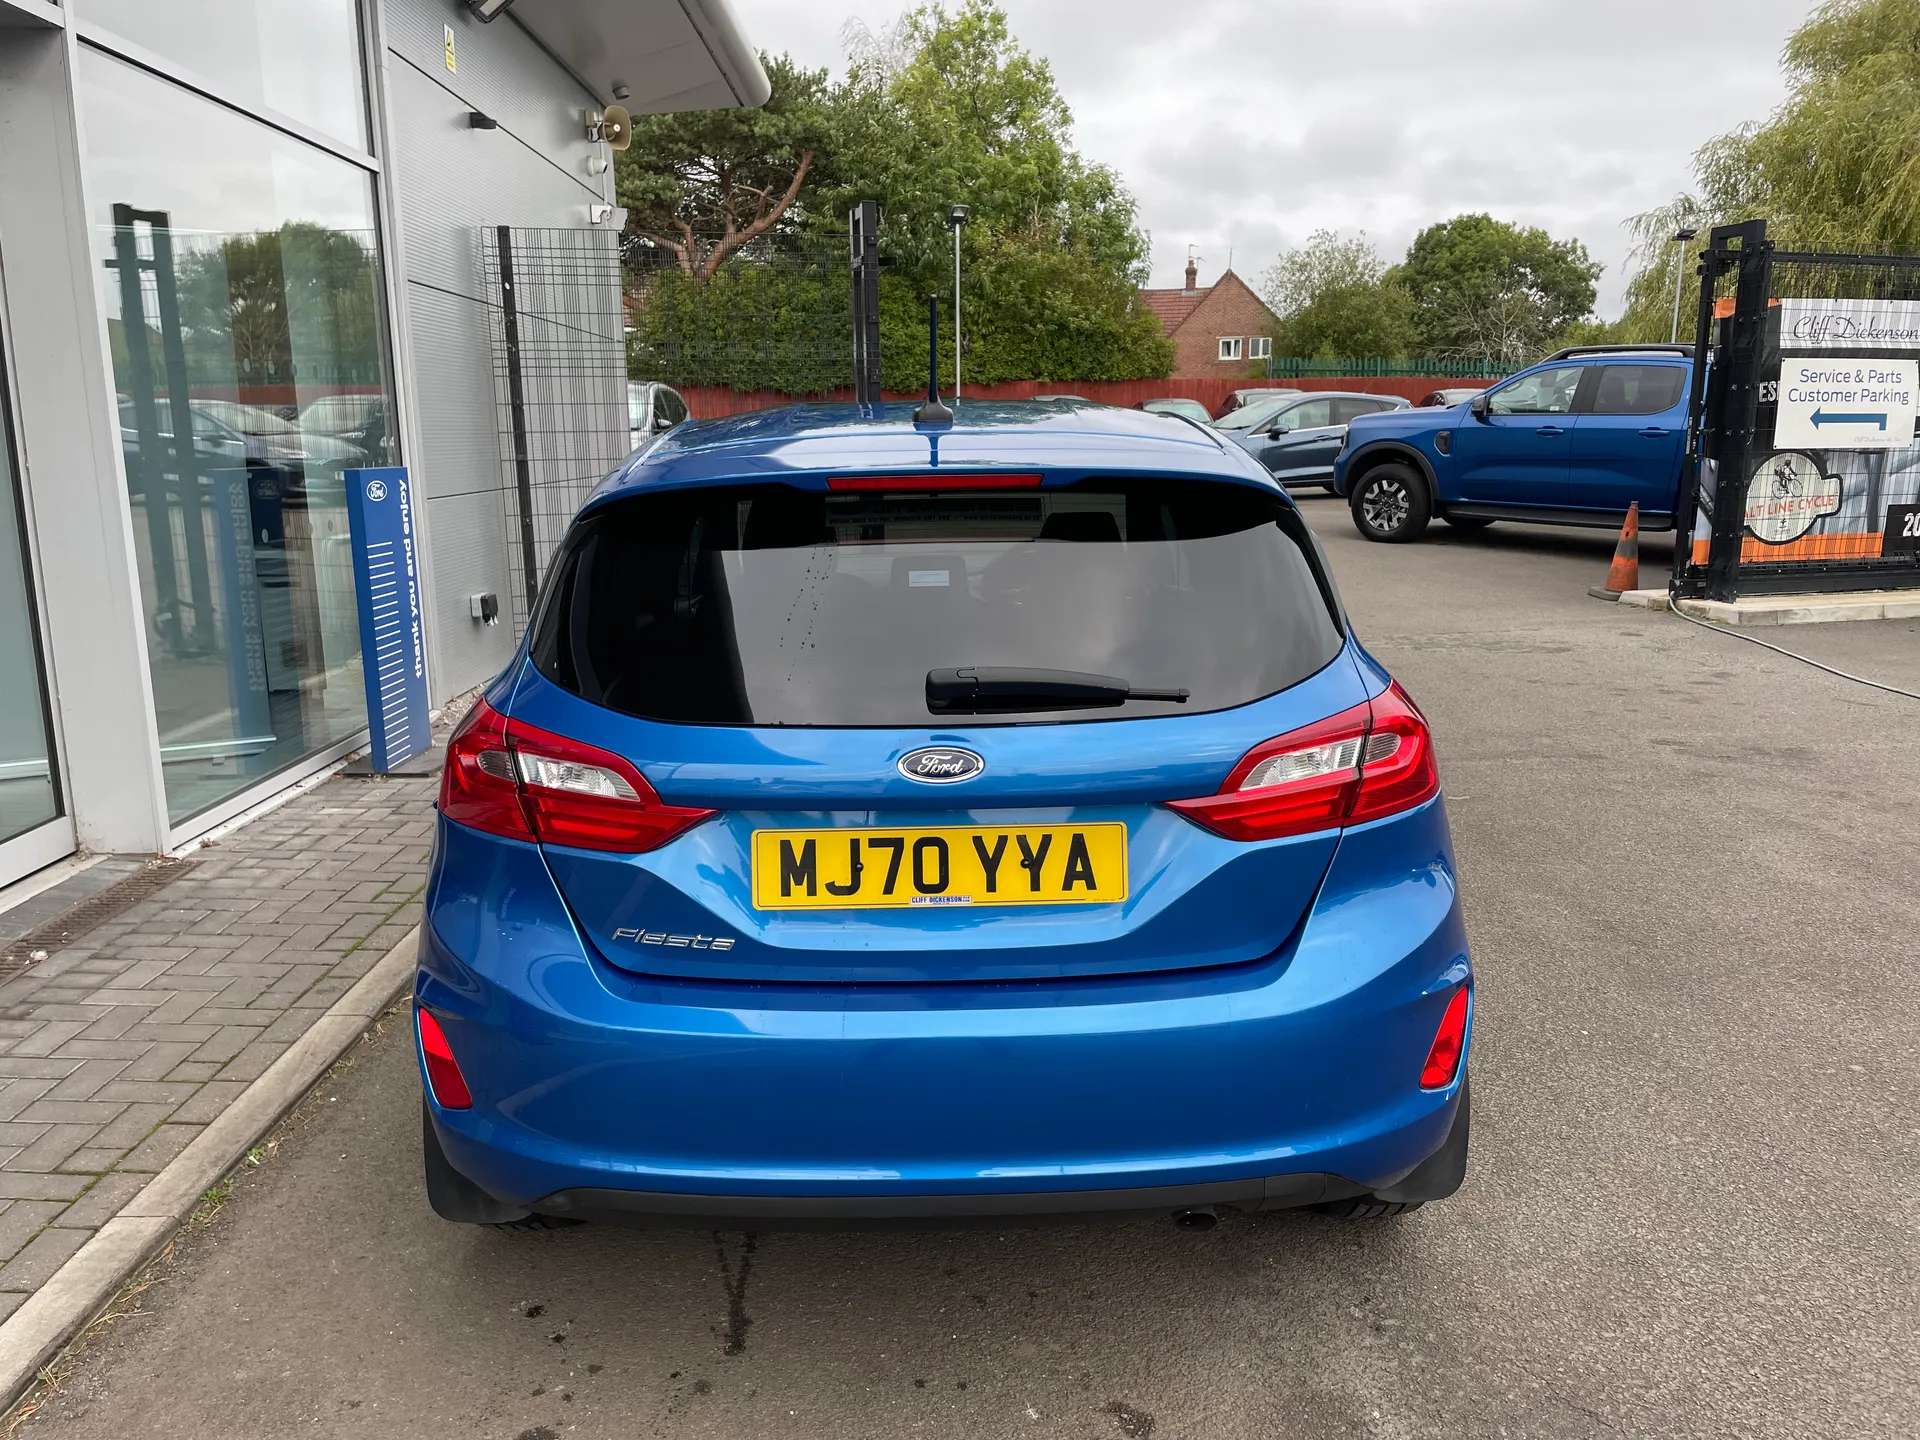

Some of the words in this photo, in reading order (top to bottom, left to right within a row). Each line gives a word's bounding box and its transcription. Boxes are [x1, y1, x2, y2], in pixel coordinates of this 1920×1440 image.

[1793, 315, 1834, 344] Cliff
[1833, 316, 1919, 340] Dickenson
[1799, 368, 1851, 383] Service
[1854, 369, 1864, 383] &
[1868, 369, 1902, 383] Parts
[1759, 380, 1780, 402] ES
[1788, 388, 1857, 403] Customer
[1861, 388, 1909, 405] Parking
[399, 480, 410, 535] enjoy
[403, 538, 414, 577] and
[408, 581, 419, 618] you
[411, 620, 422, 679] thank
[917, 754, 964, 774] Ford
[779, 836, 950, 897] MJ70
[972, 833, 1097, 893] YYA
[911, 896, 928, 904] CLIFF
[611, 927, 736, 951] Fiesta
